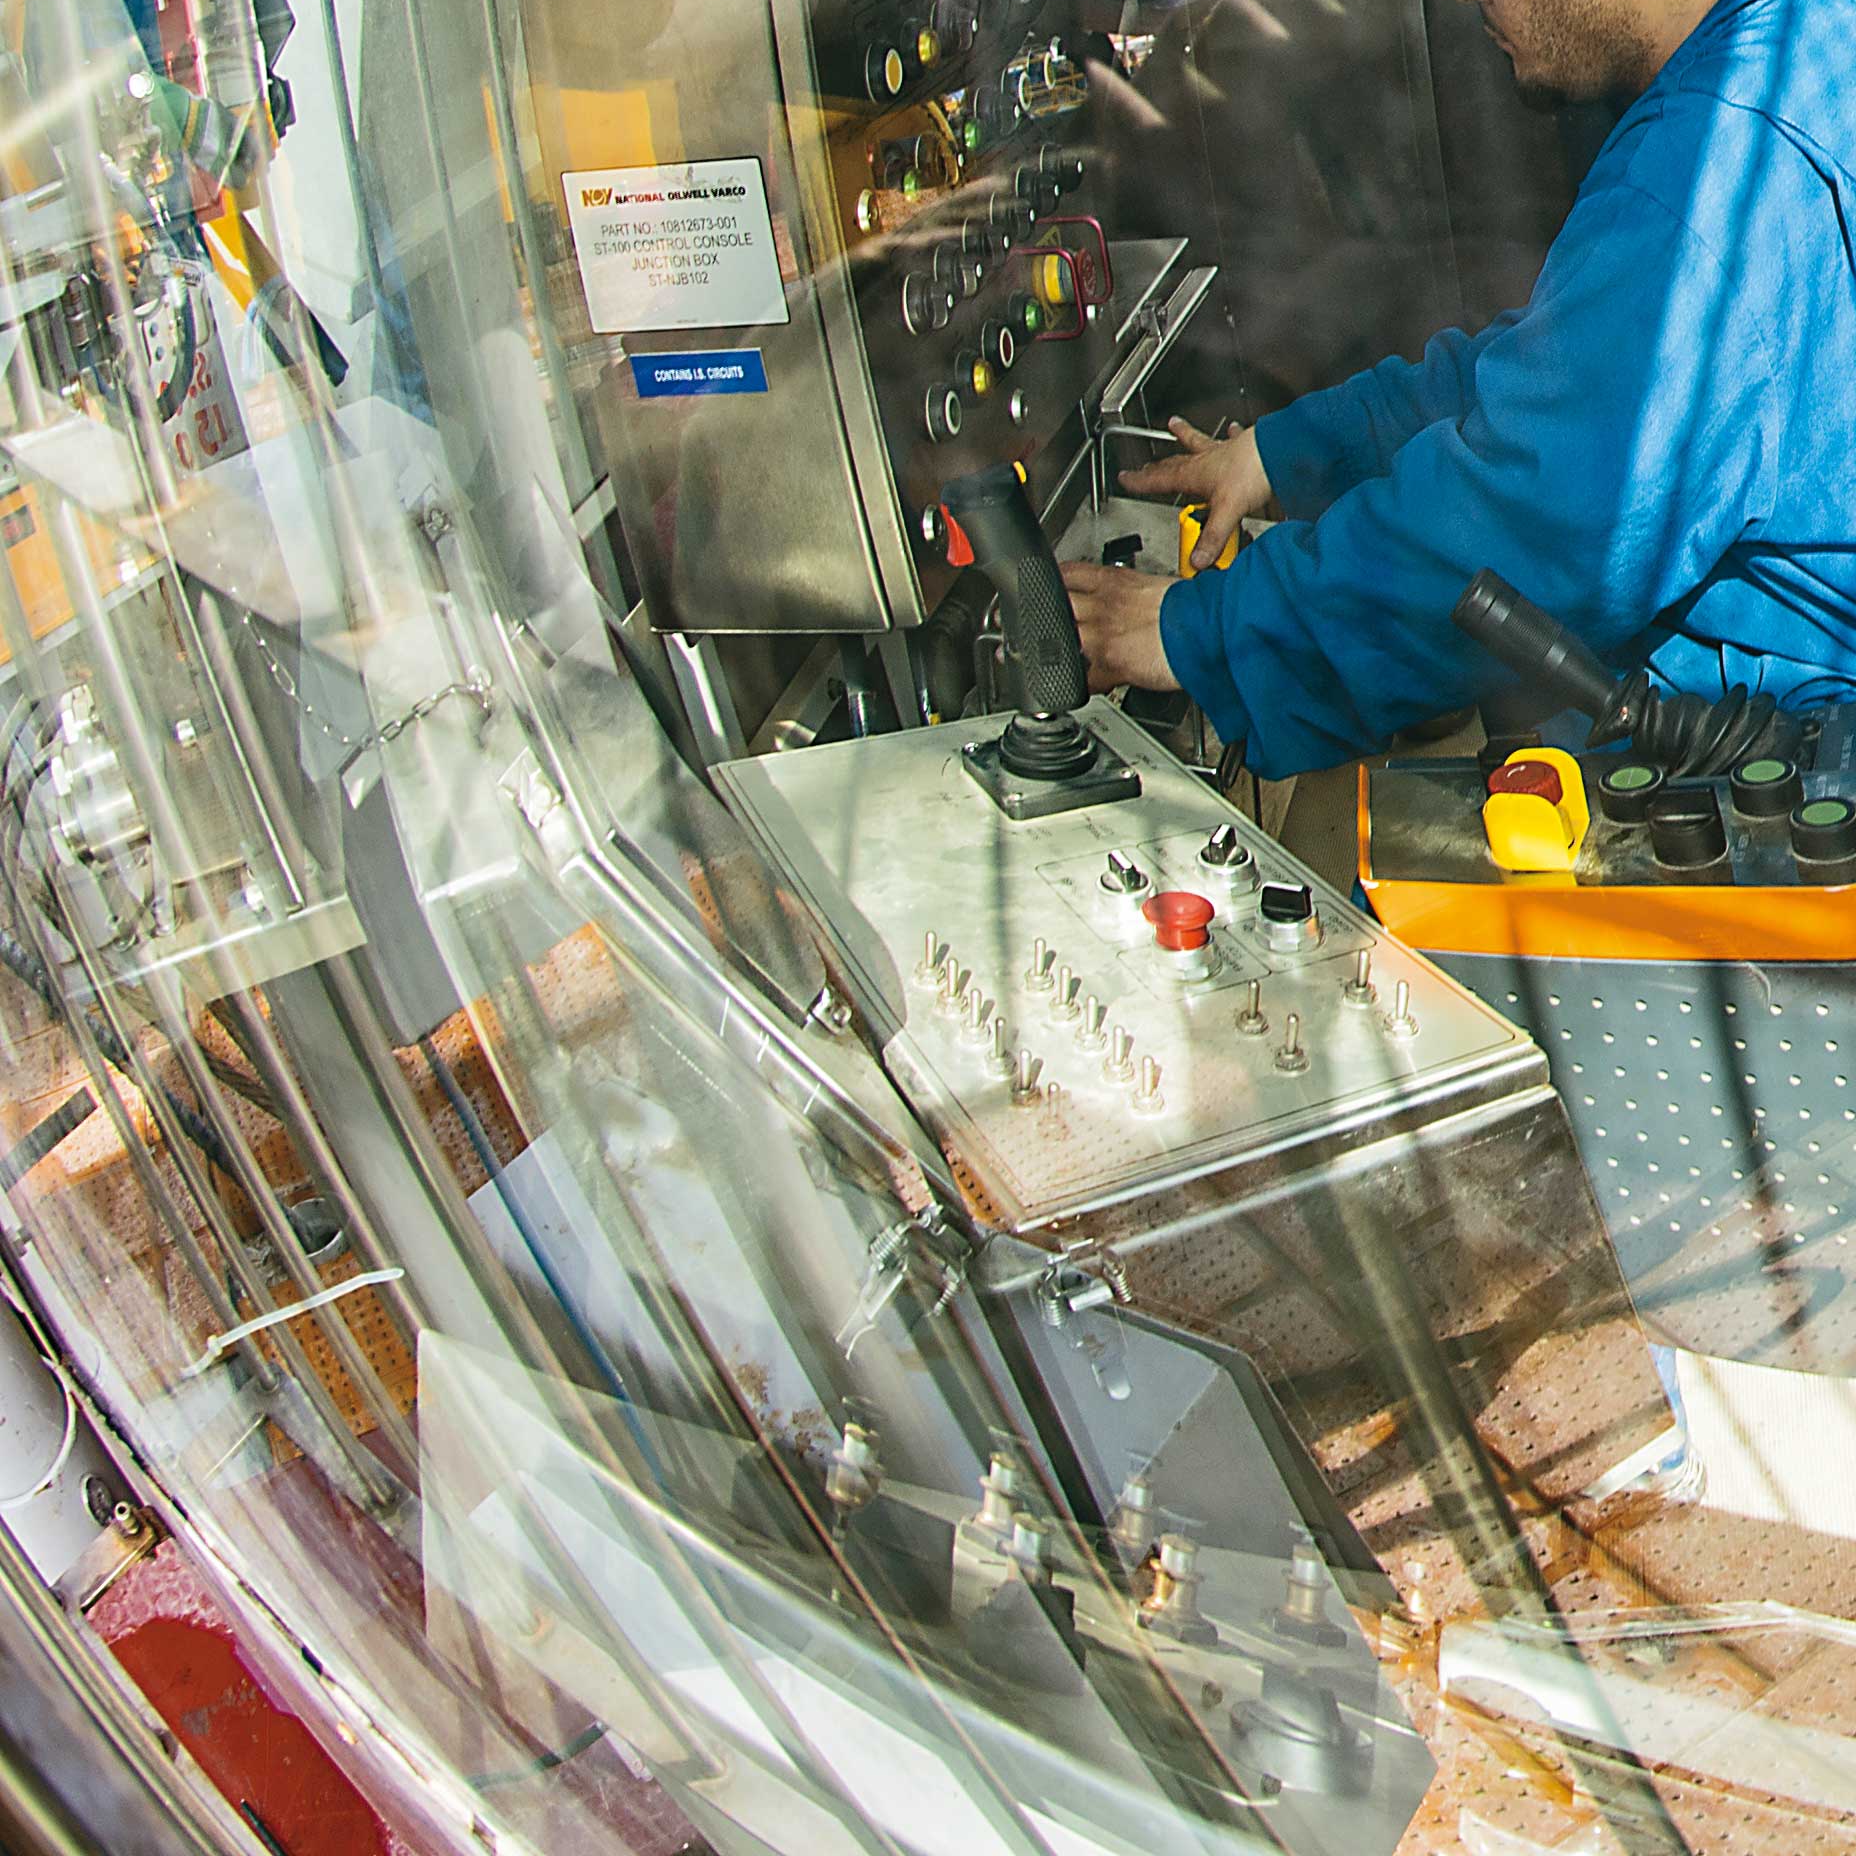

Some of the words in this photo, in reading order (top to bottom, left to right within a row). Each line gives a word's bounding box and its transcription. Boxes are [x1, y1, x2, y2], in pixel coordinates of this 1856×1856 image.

[581, 187, 613, 208] NOV
[614, 193, 665, 205] NATIONAL
[667, 188, 710, 201] OILWELL
[710, 186, 746, 199] VARCO
[601, 222, 630, 238] PART
[660, 216, 738, 235] 10812673-001
[594, 242, 631, 256] ST-100
[633, 236, 691, 254] CONTROL
[693, 232, 753, 250] CONSOLE
[631, 254, 691, 271] JUNCTION
[694, 253, 720, 266] BOX
[648, 271, 709, 288] ST-NJB102
[654, 367, 693, 383] CONTAINS
[706, 365, 744, 380] CIRCUITS
